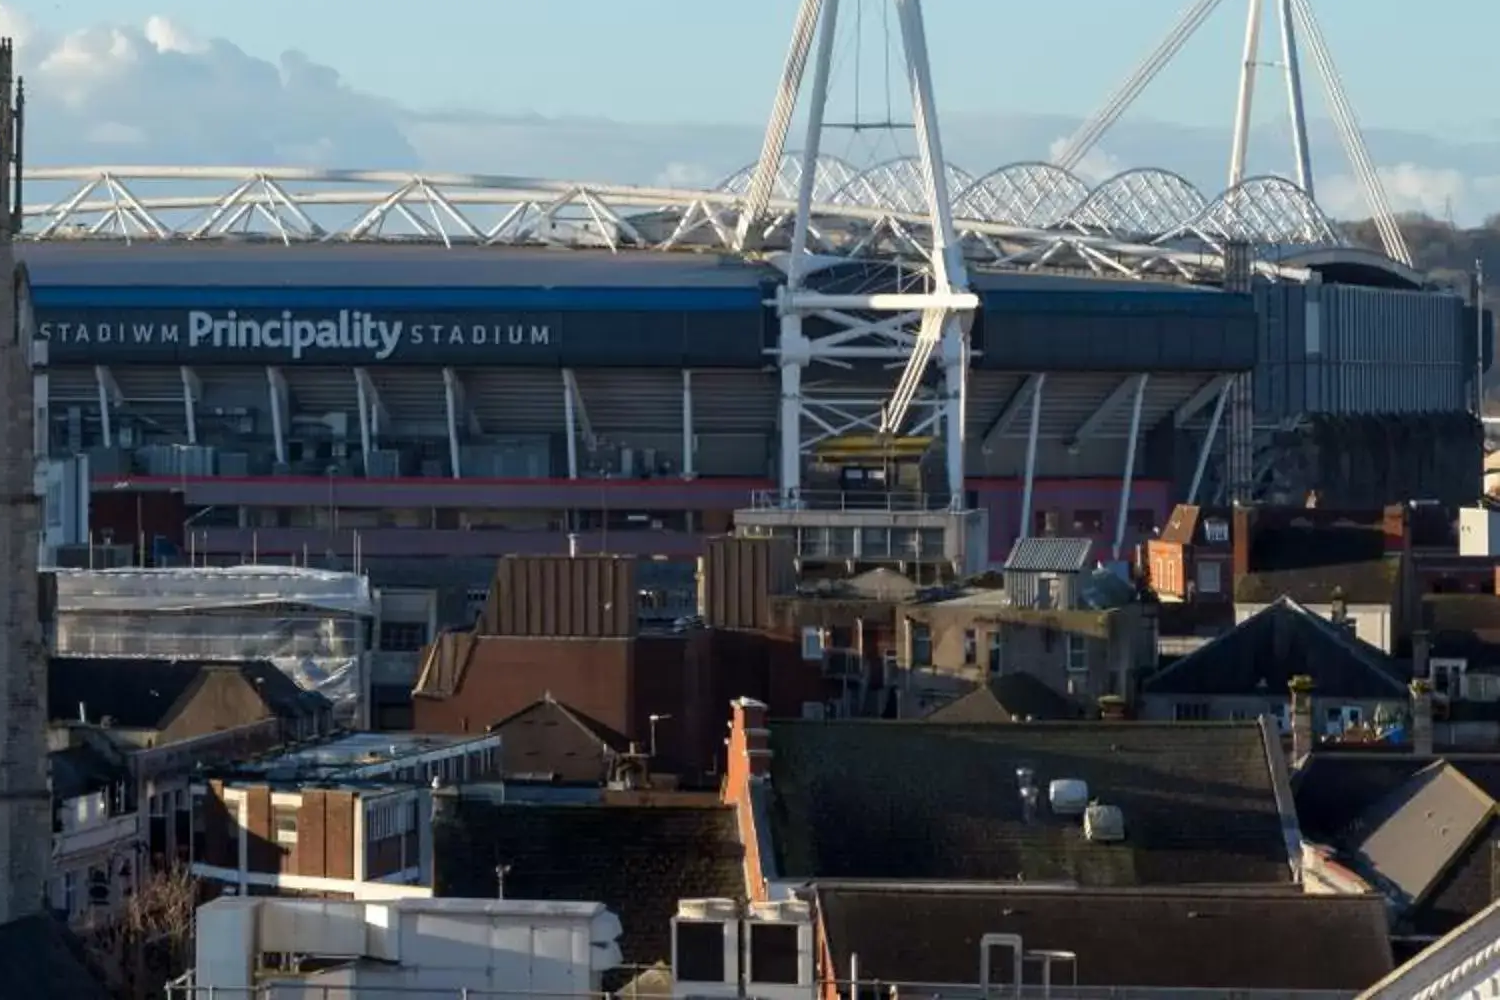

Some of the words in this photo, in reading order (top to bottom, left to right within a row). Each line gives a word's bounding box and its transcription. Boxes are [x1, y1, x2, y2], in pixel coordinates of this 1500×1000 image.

[40, 323, 179, 343] STADIWM
[188, 310, 403, 358] Principality
[410, 324, 550, 345] STADIUM
